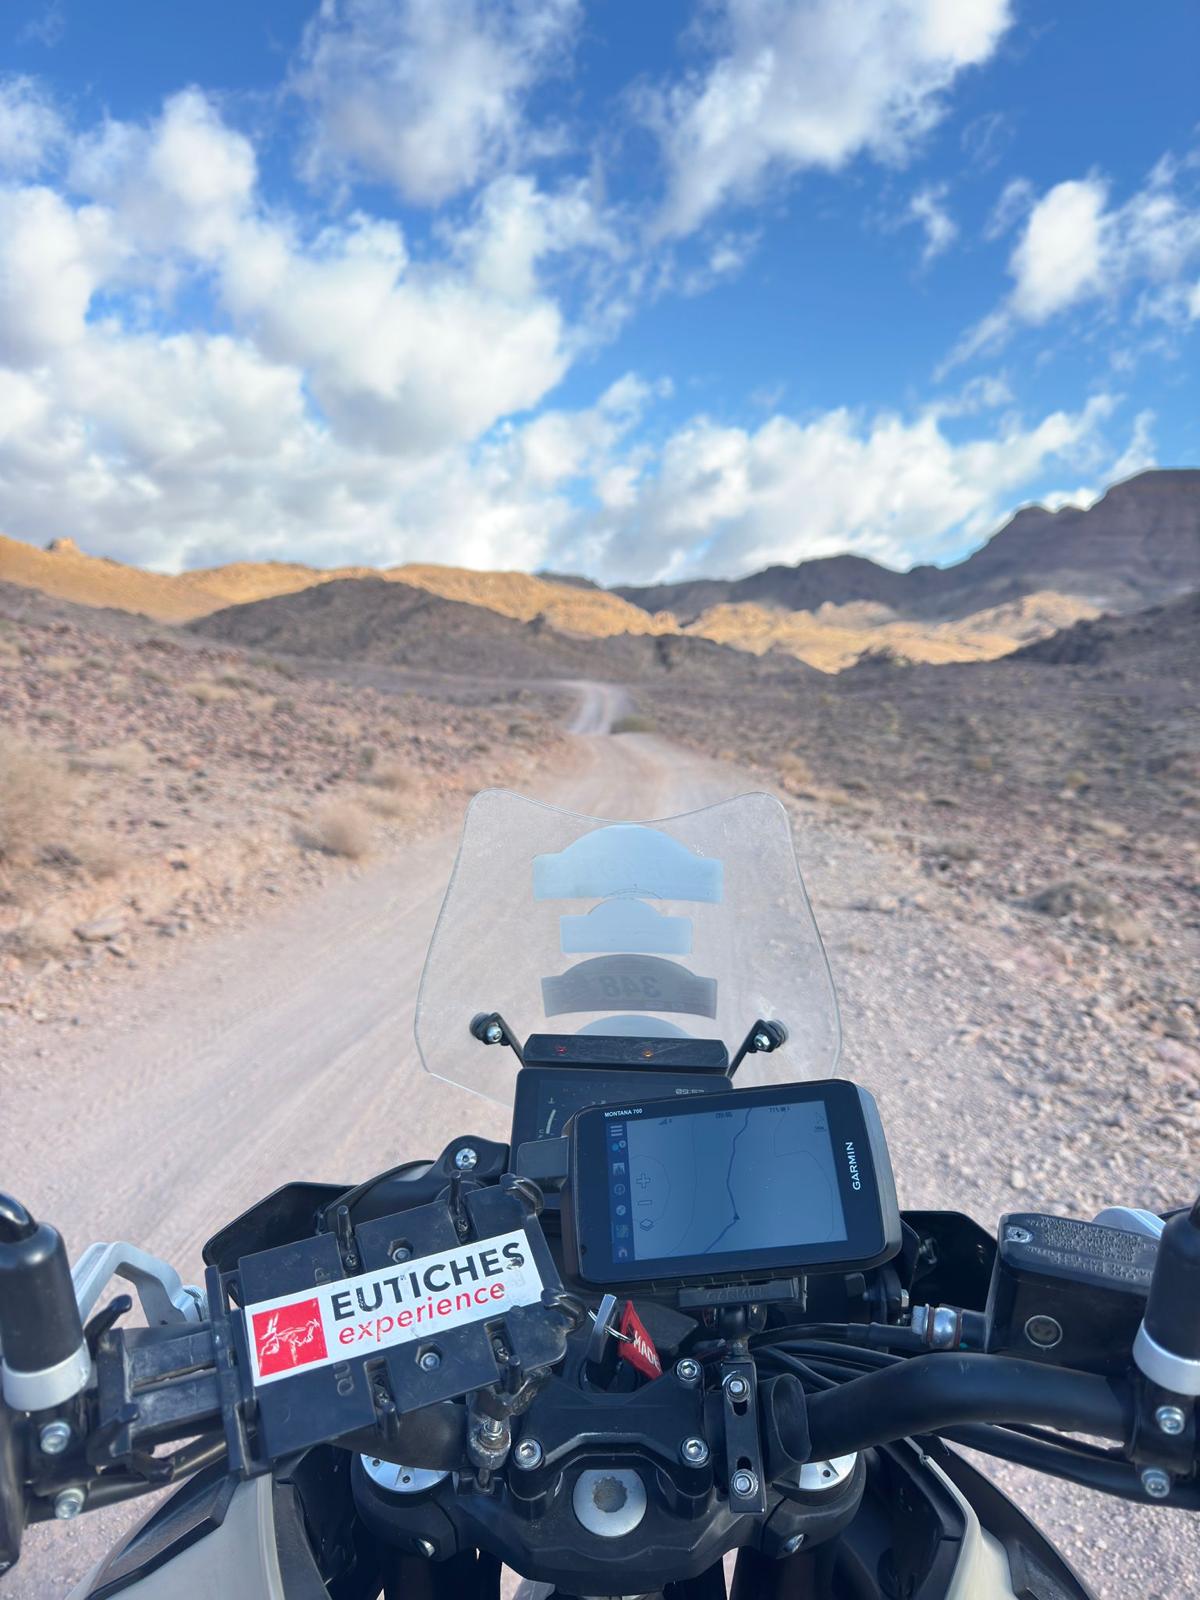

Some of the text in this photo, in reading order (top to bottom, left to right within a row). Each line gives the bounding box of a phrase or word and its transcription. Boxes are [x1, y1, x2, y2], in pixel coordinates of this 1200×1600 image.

[604, 1109, 632, 1118] MONTANA
[845, 1141, 861, 1190] GARMIN
[330, 1242, 525, 1321] EUTICHES
[338, 1282, 505, 1345] experience
